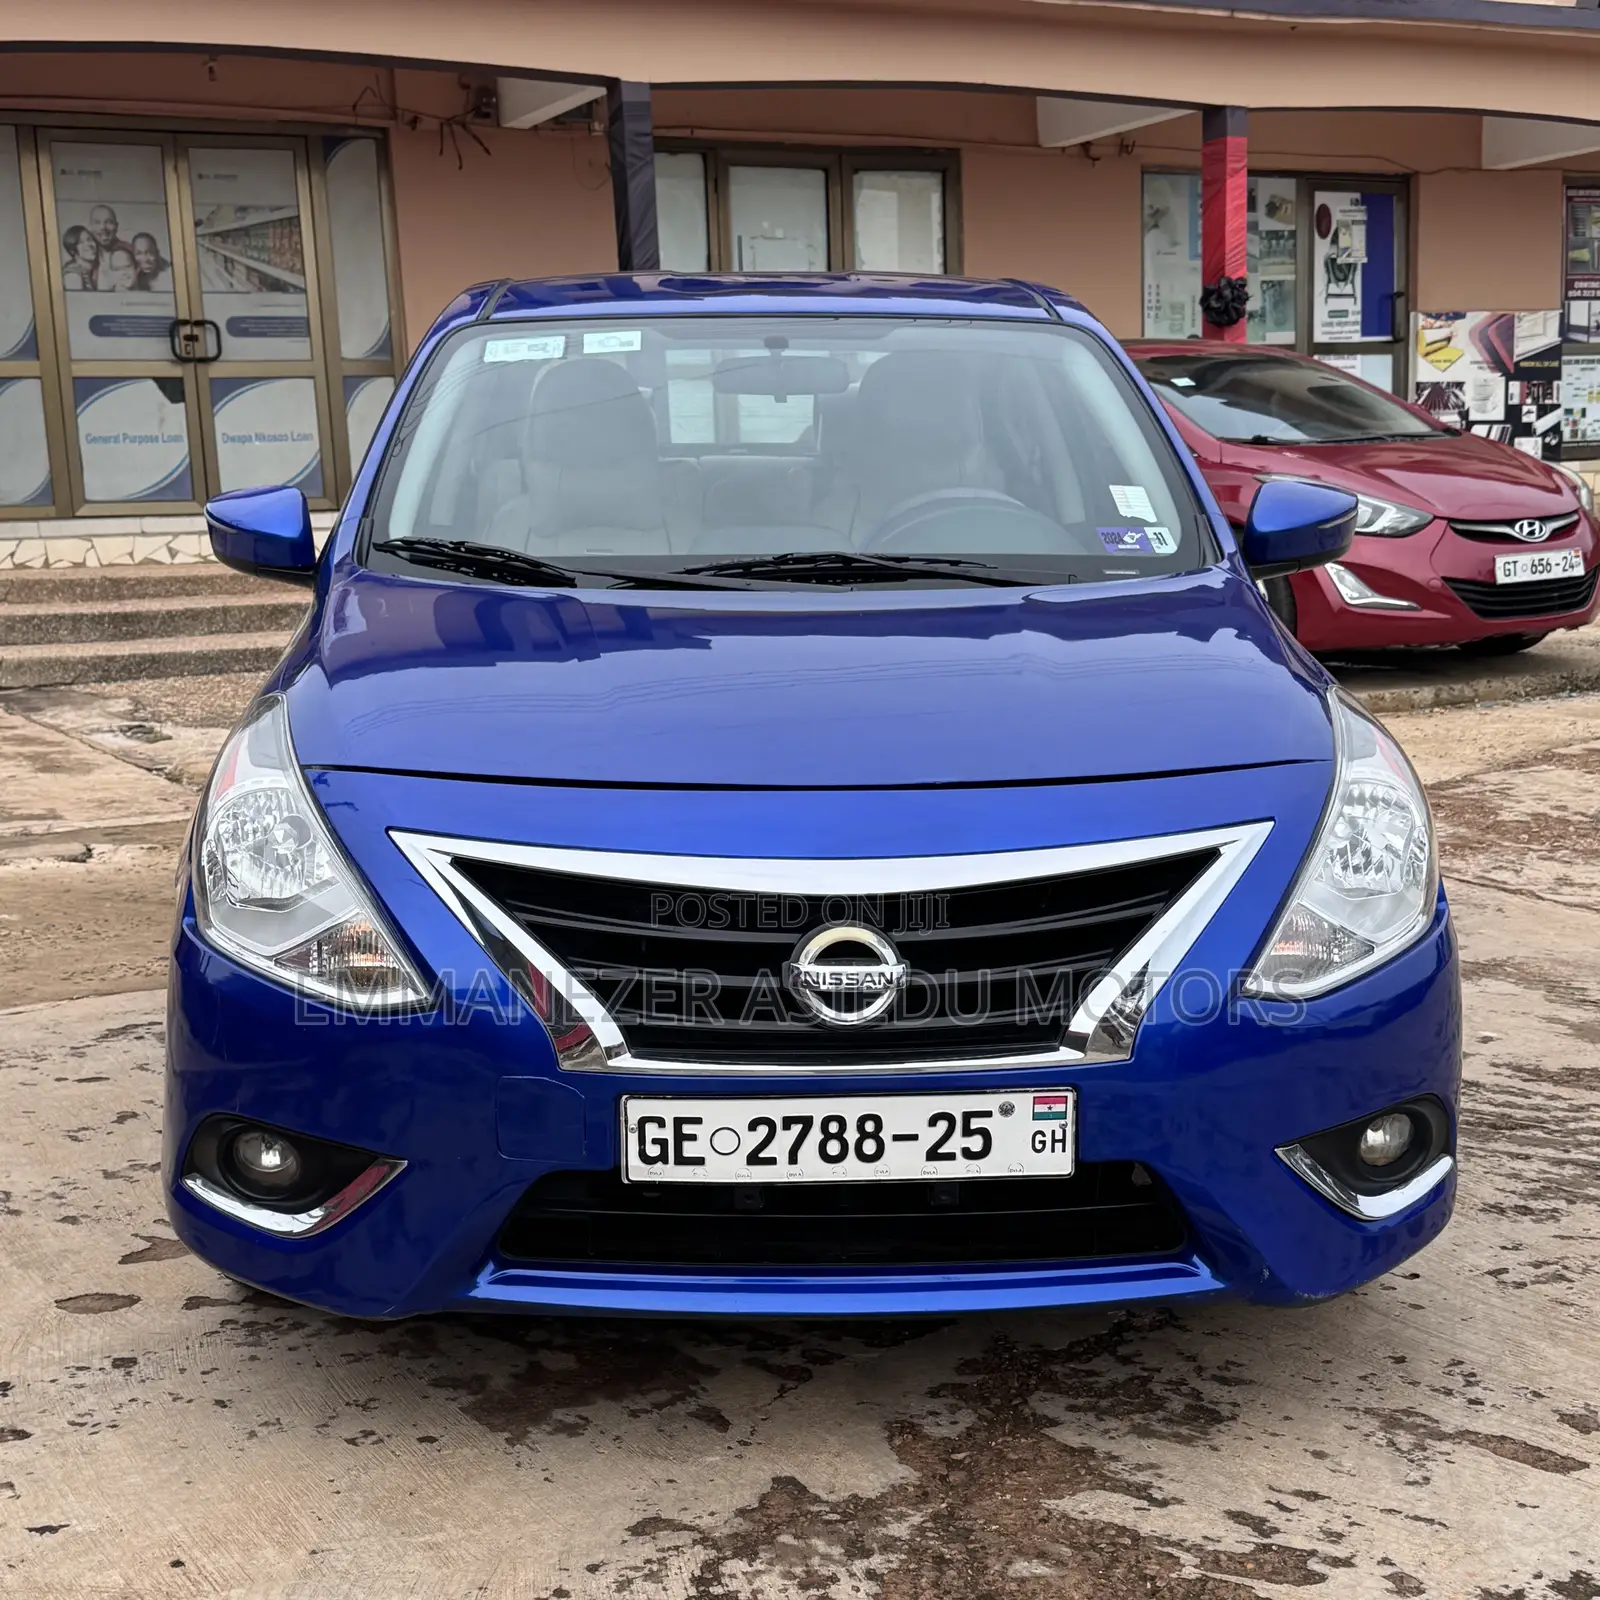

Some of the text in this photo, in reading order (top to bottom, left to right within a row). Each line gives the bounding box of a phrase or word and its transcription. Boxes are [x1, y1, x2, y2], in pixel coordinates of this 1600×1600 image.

[85, 432, 185, 446] General Purpose Loan
[290, 431, 314, 442] Loan
[1503, 556, 1575, 577] GT 656-24
[803, 971, 894, 986] NISSAN
[637, 1110, 994, 1166] GE 2788-25
[1030, 1127, 1068, 1154] GH
